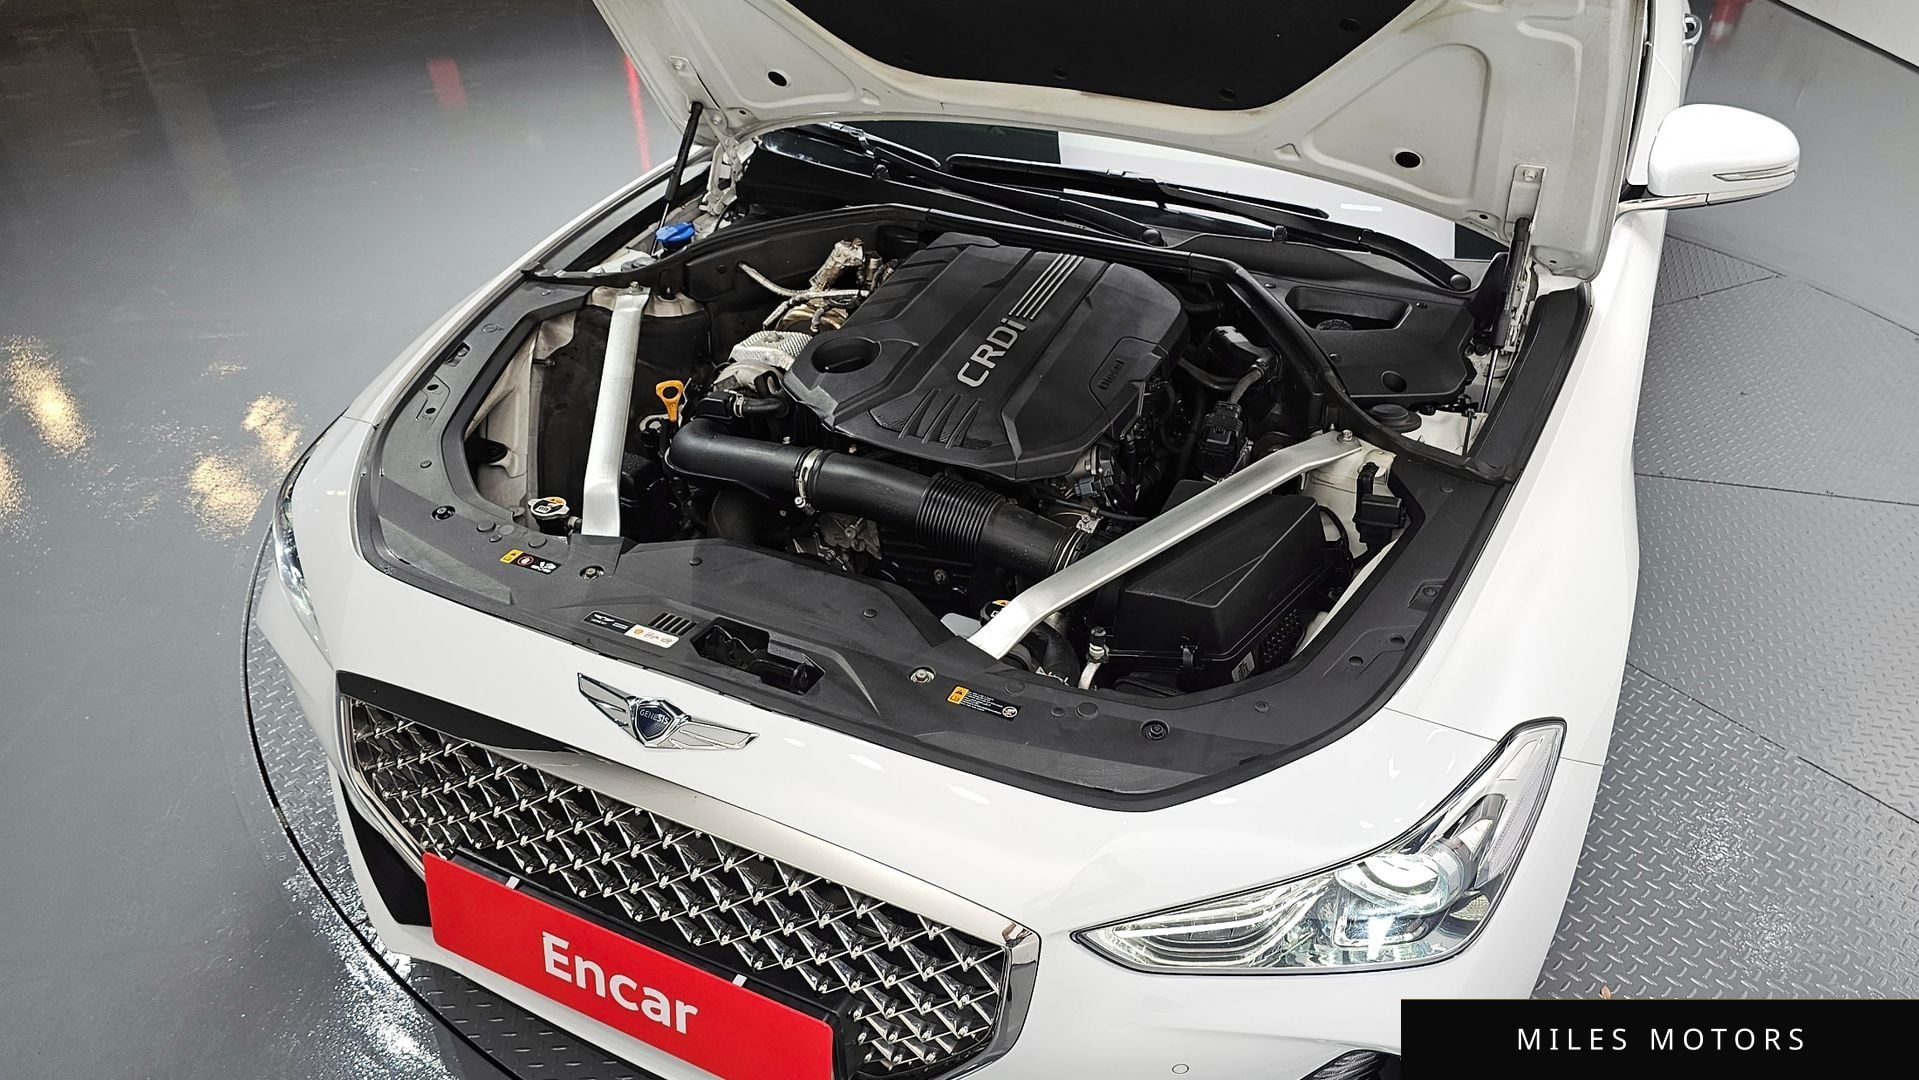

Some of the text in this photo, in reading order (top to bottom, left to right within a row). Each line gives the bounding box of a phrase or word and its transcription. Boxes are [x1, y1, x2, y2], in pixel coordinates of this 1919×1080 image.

[957, 317, 1027, 387] CRDi
[1097, 359, 1125, 390] Diesel
[640, 709, 670, 725] GENESIS
[542, 931, 699, 1035] Encar
